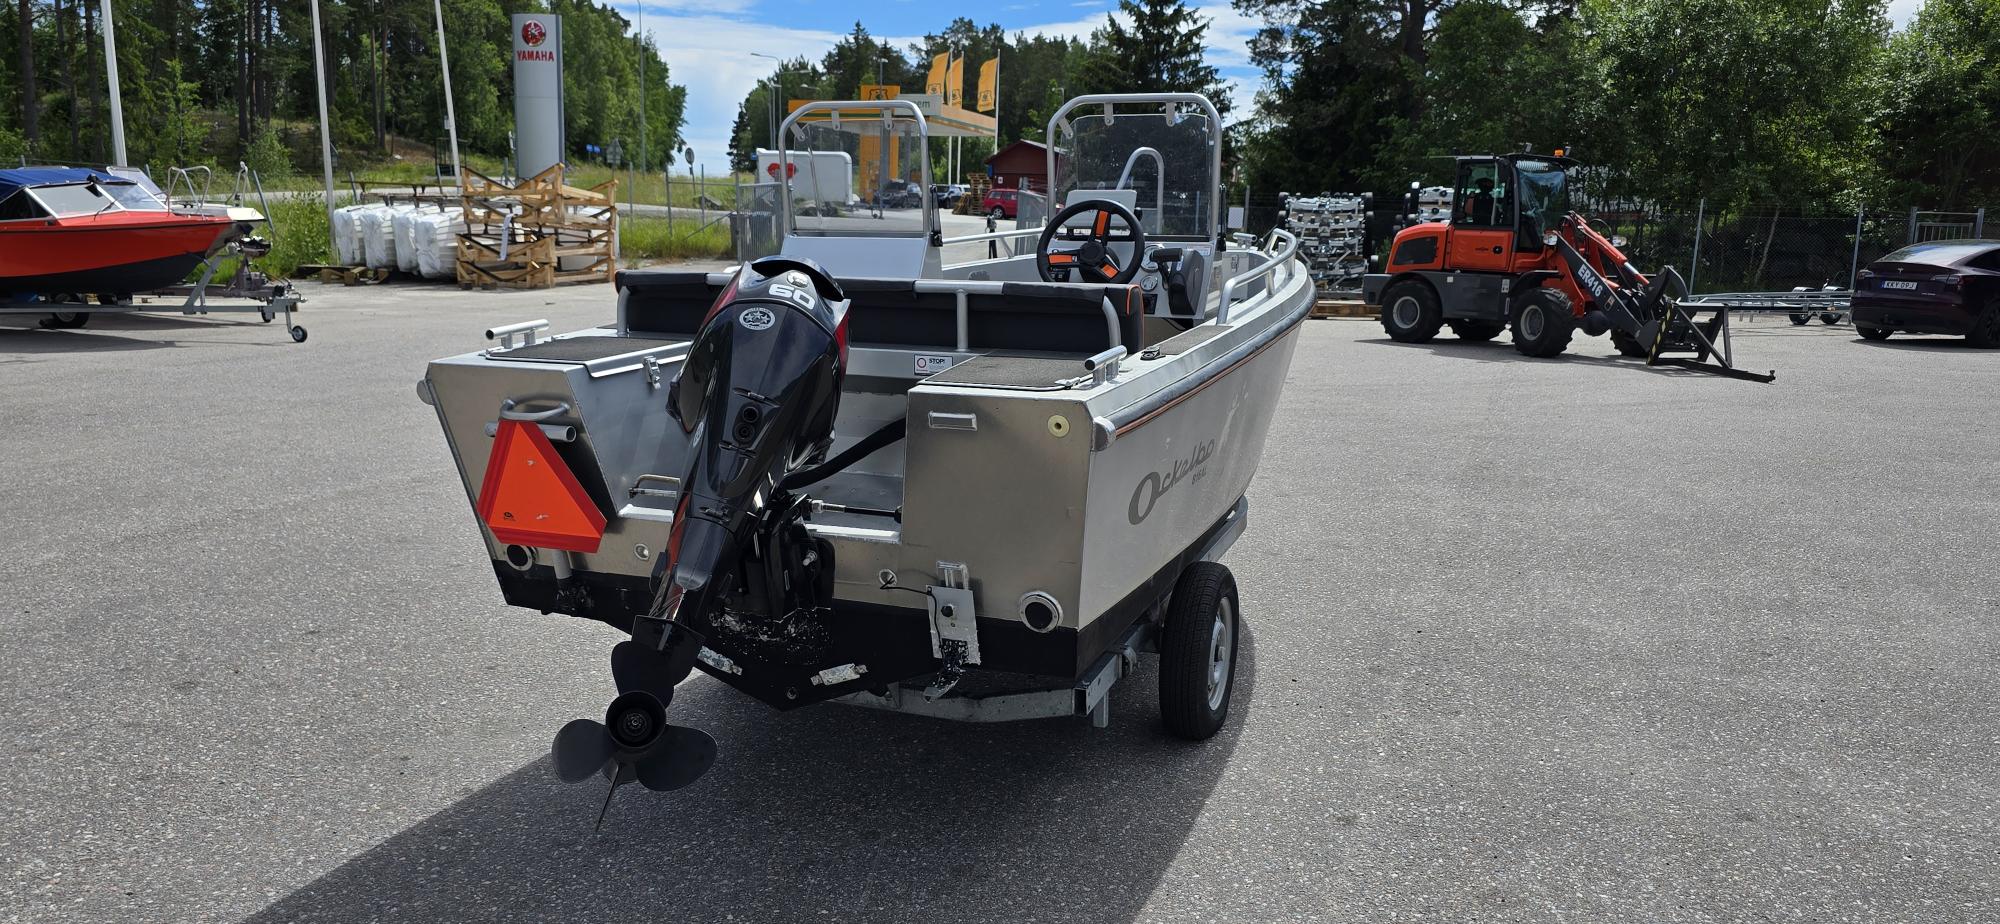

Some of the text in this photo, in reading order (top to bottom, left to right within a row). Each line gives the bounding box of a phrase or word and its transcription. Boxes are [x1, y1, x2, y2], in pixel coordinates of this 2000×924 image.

[516, 50, 555, 62] YAMAHA
[1577, 263, 1603, 297] ER416
[768, 283, 816, 310] 60
[1127, 438, 1216, 526] Ockelbo
